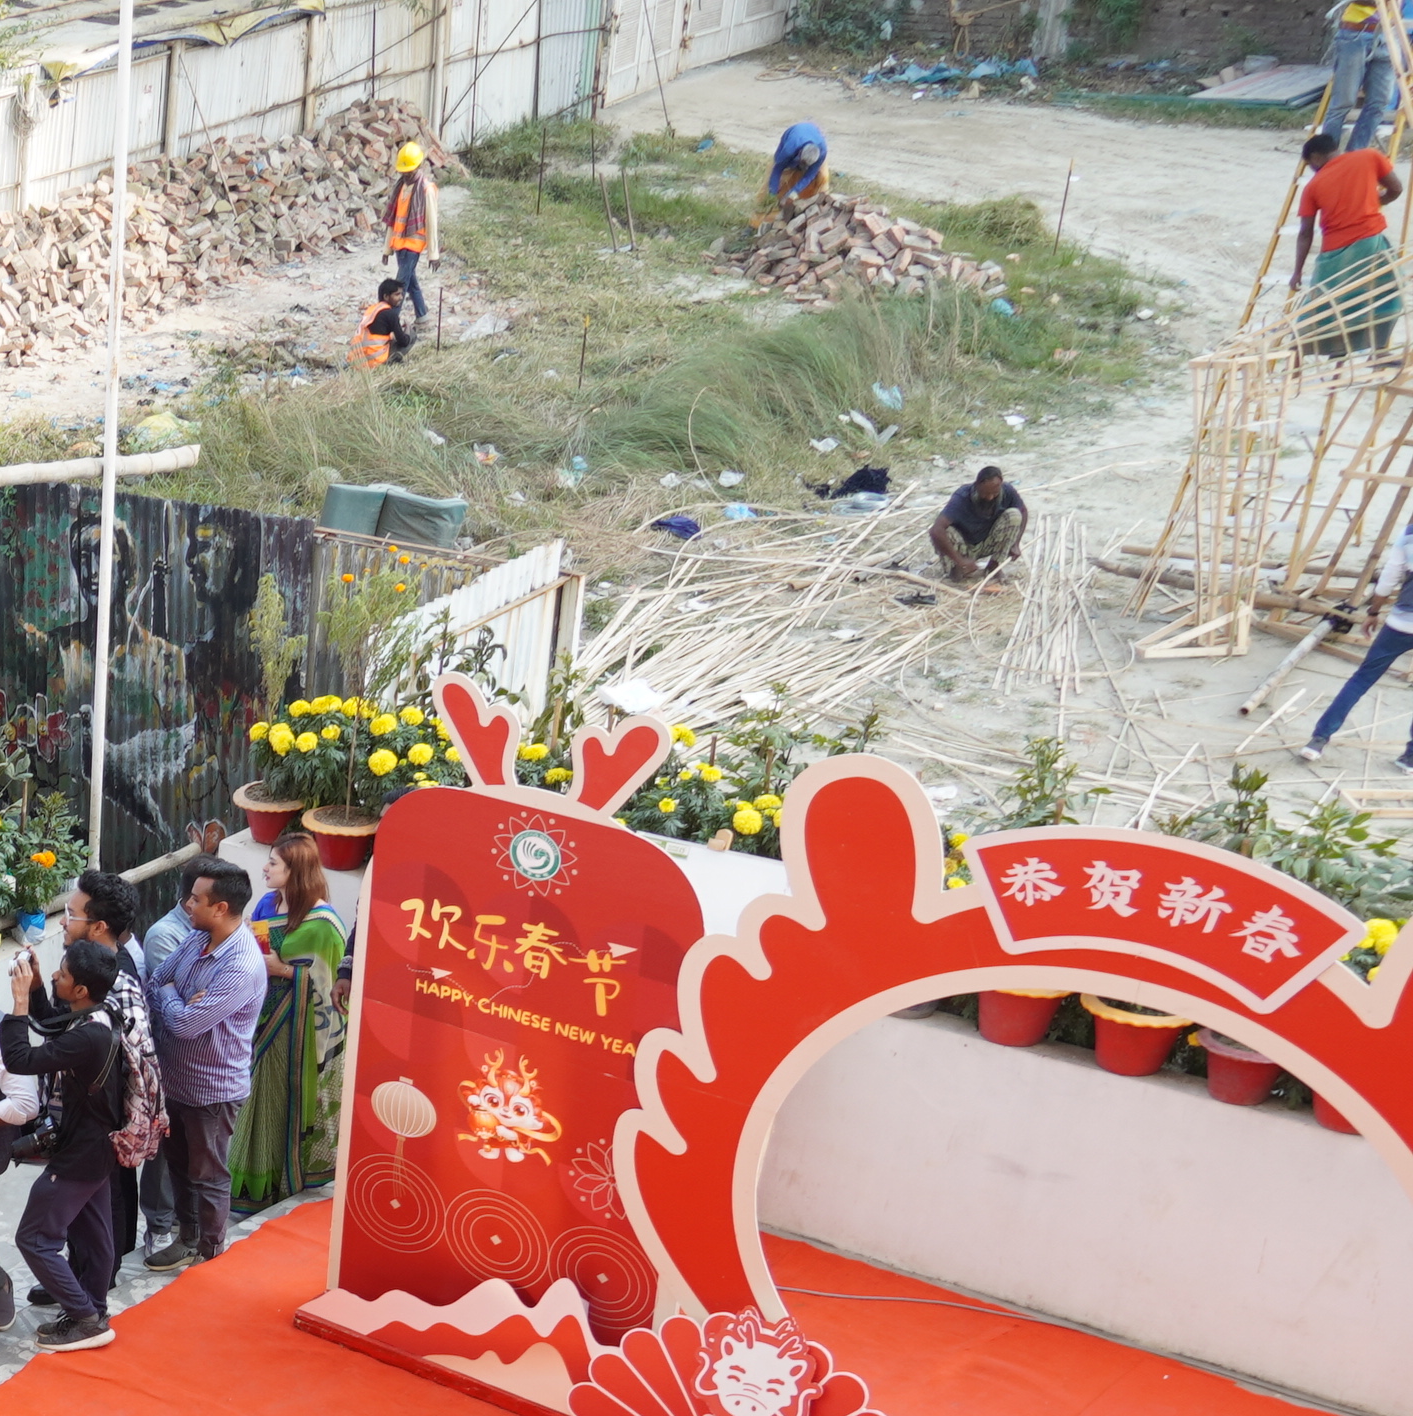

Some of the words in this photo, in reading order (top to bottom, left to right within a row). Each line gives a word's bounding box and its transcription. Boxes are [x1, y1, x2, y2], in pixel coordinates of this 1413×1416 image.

[400, 898, 627, 1017] 欢乐春节
[1000, 857, 1303, 963] 恭贺新春
[415, 978, 474, 1007] HAPPY
[477, 998, 551, 1032] CHINESE
[555, 1021, 596, 1045] NEW
[600, 1034, 636, 1058] YEA
